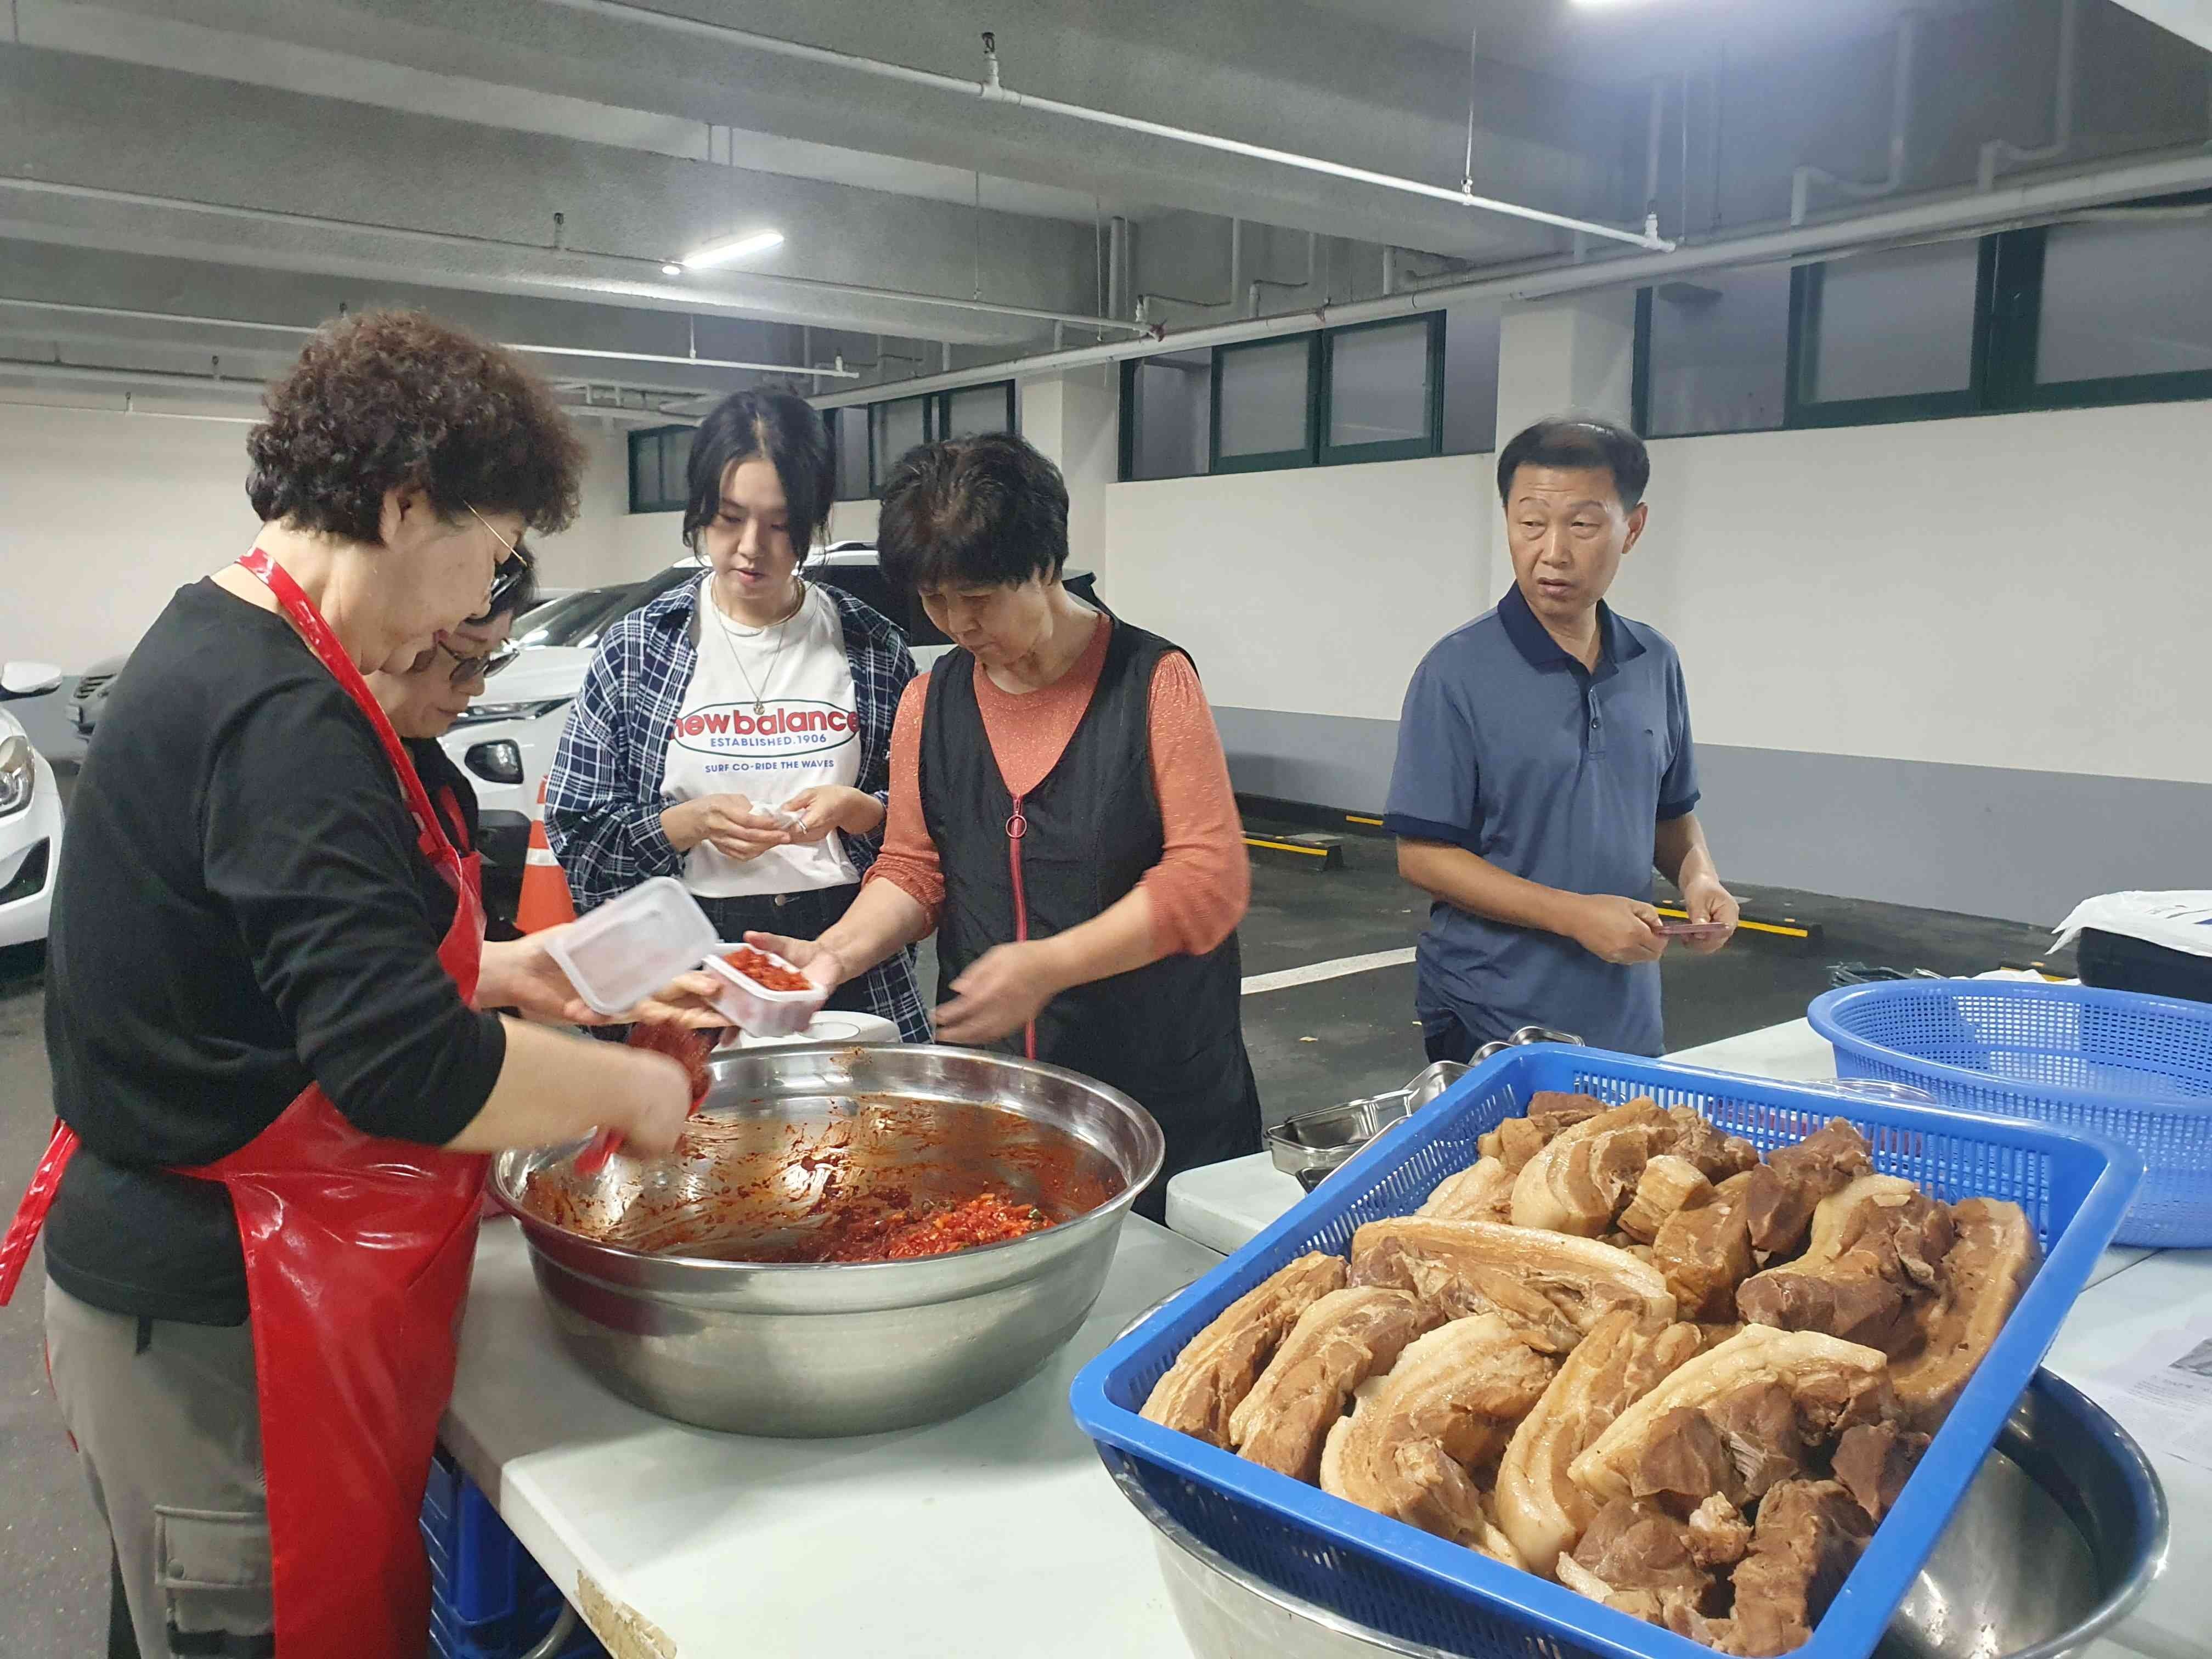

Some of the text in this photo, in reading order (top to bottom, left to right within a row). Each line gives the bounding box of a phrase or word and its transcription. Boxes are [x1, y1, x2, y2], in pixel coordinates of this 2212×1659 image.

[705, 764, 729, 772] SURF
[732, 763, 777, 771] CO-RIDE
[801, 760, 834, 768] WAVES
